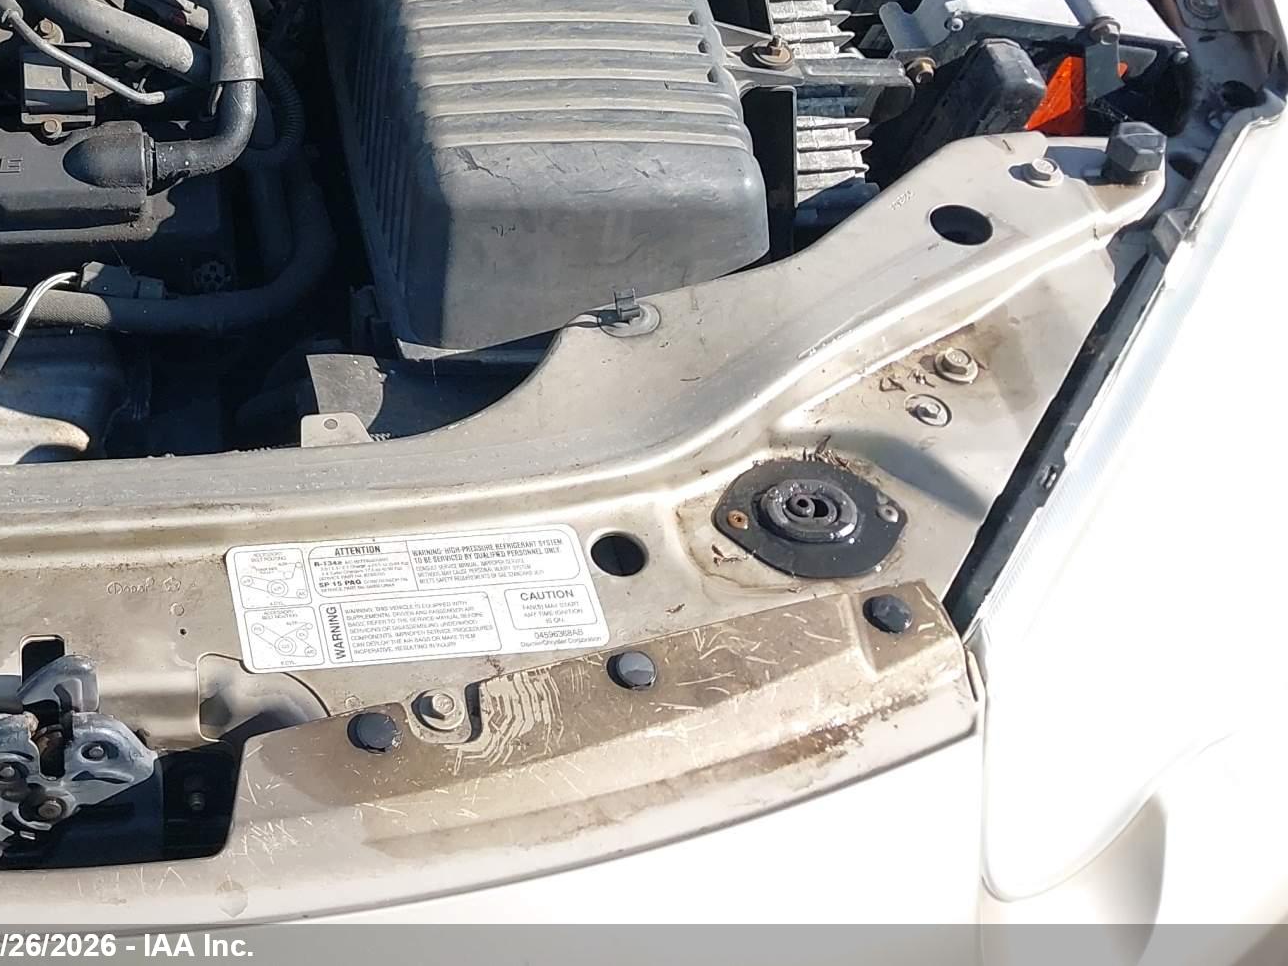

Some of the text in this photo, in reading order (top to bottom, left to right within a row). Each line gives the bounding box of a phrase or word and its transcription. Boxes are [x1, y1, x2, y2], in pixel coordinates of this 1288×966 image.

[494, 540, 537, 549] REFRIGERANT
[538, 538, 563, 546] SYSTEM
[334, 545, 381, 555] ATTENTION
[432, 554, 463, 562] SERVICED
[473, 551, 506, 559] QUALIFIED
[506, 548, 544, 556] PERSONNEL
[519, 589, 574, 601] CAUTION
[326, 606, 346, 659] WARNING
